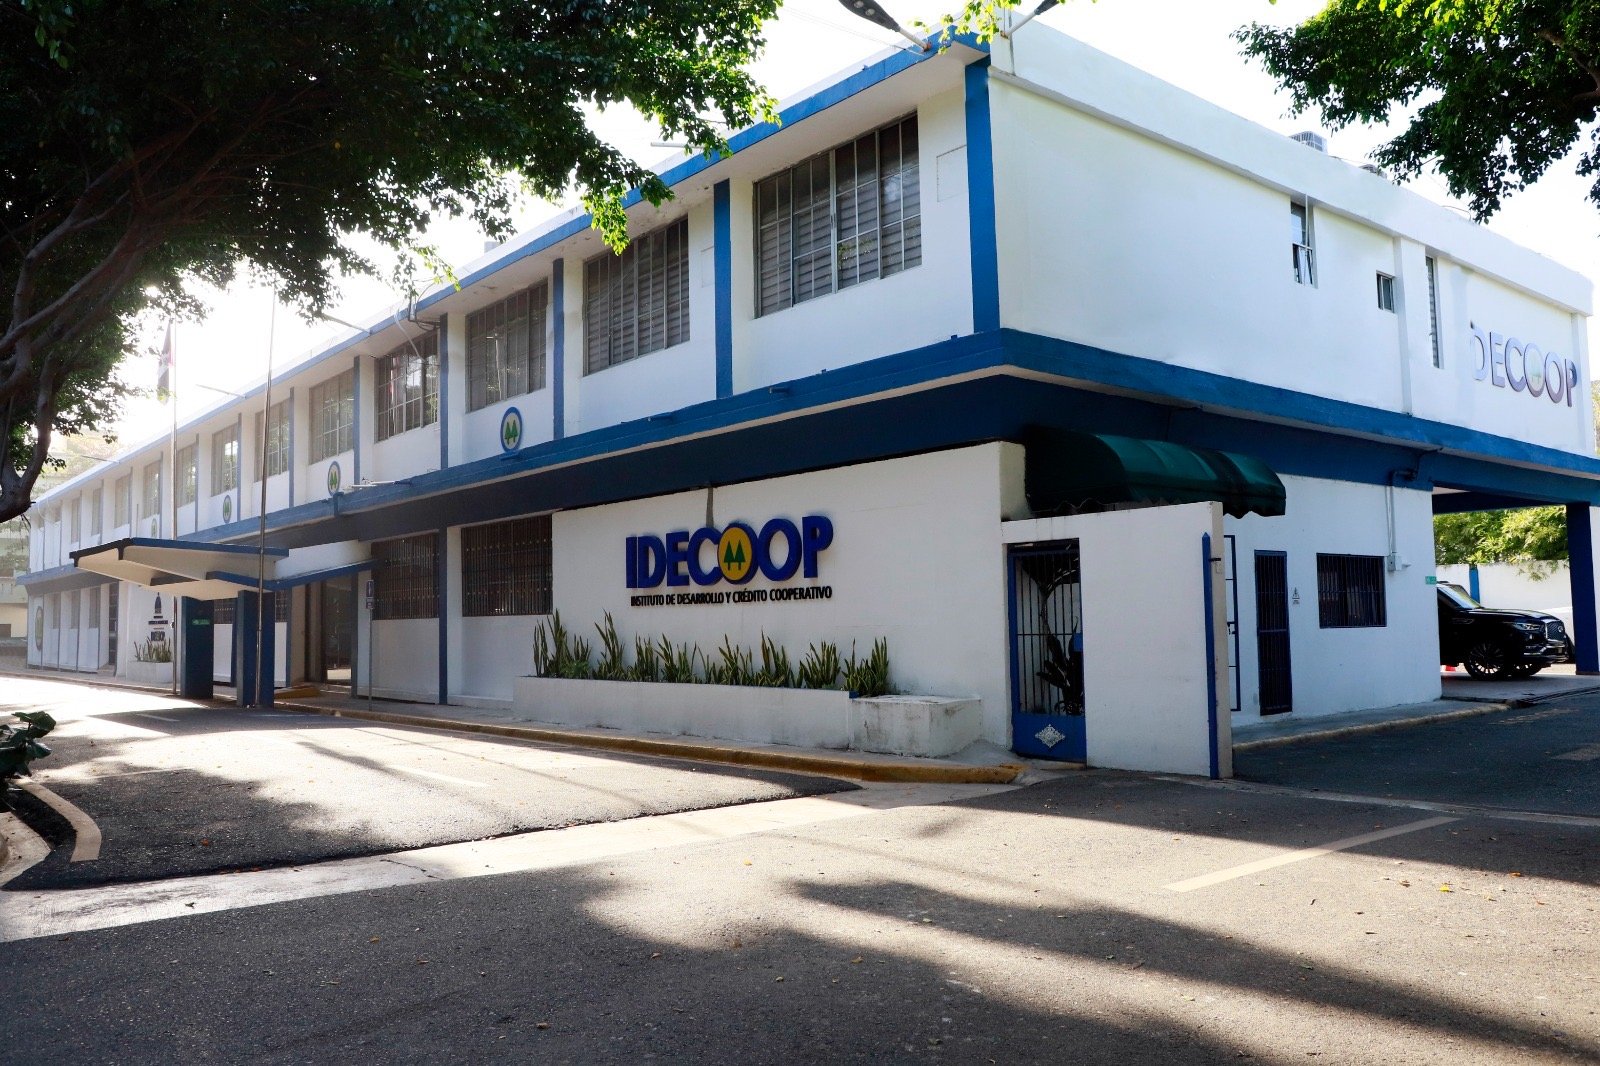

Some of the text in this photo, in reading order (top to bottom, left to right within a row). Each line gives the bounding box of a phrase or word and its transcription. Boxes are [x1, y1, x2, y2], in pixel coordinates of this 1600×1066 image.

[625, 516, 834, 589] IDECOOP
[631, 585, 833, 607] INSTITUTO DE DESARROLLO Y CRÉDITO COOPERATIVO
